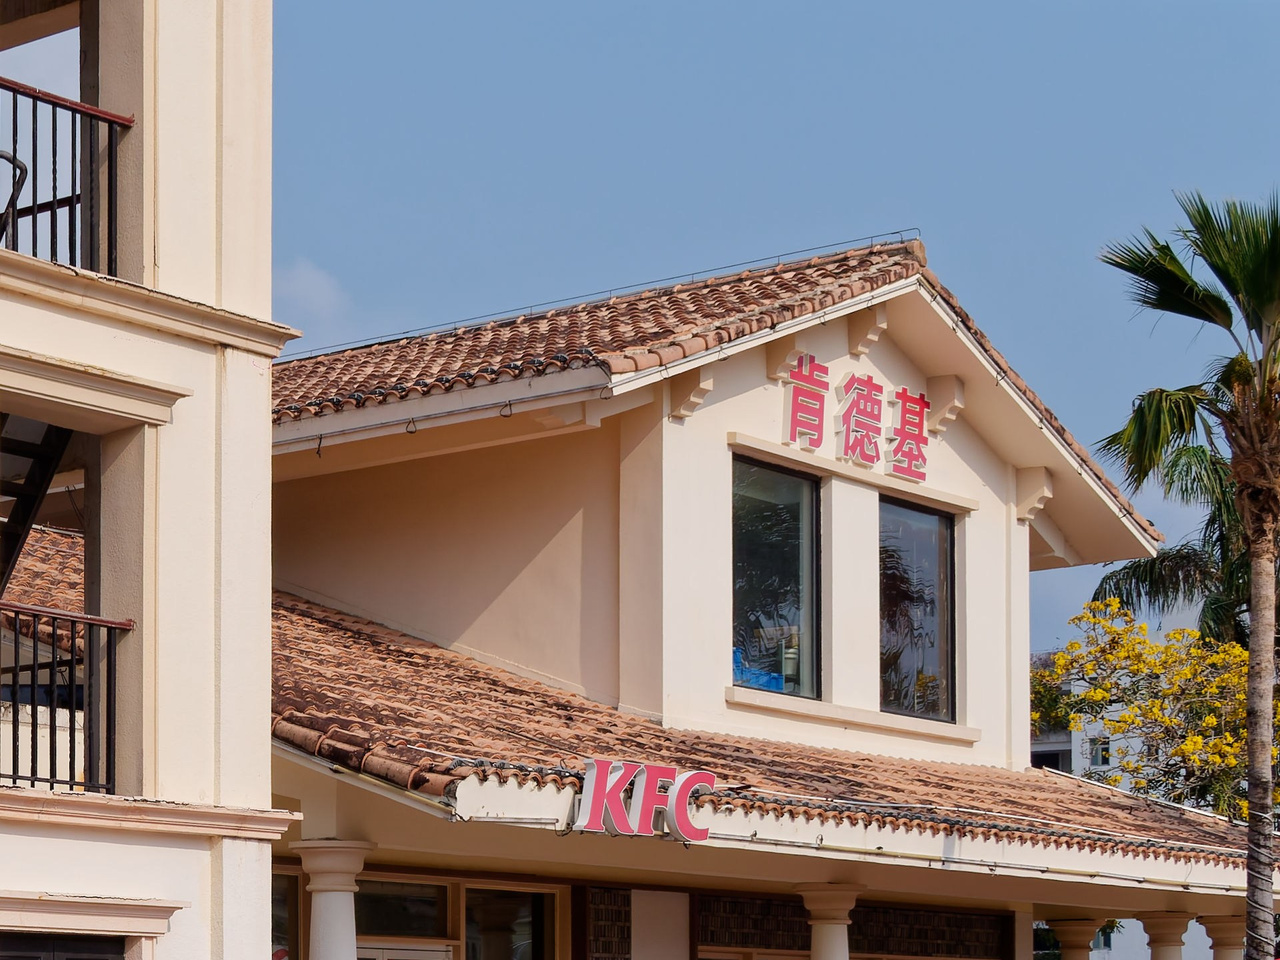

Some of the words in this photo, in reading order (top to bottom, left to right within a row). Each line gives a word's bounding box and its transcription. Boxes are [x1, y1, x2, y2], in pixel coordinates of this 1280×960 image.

[787, 354, 931, 482] 肯德基
[580, 758, 716, 842] KFC
